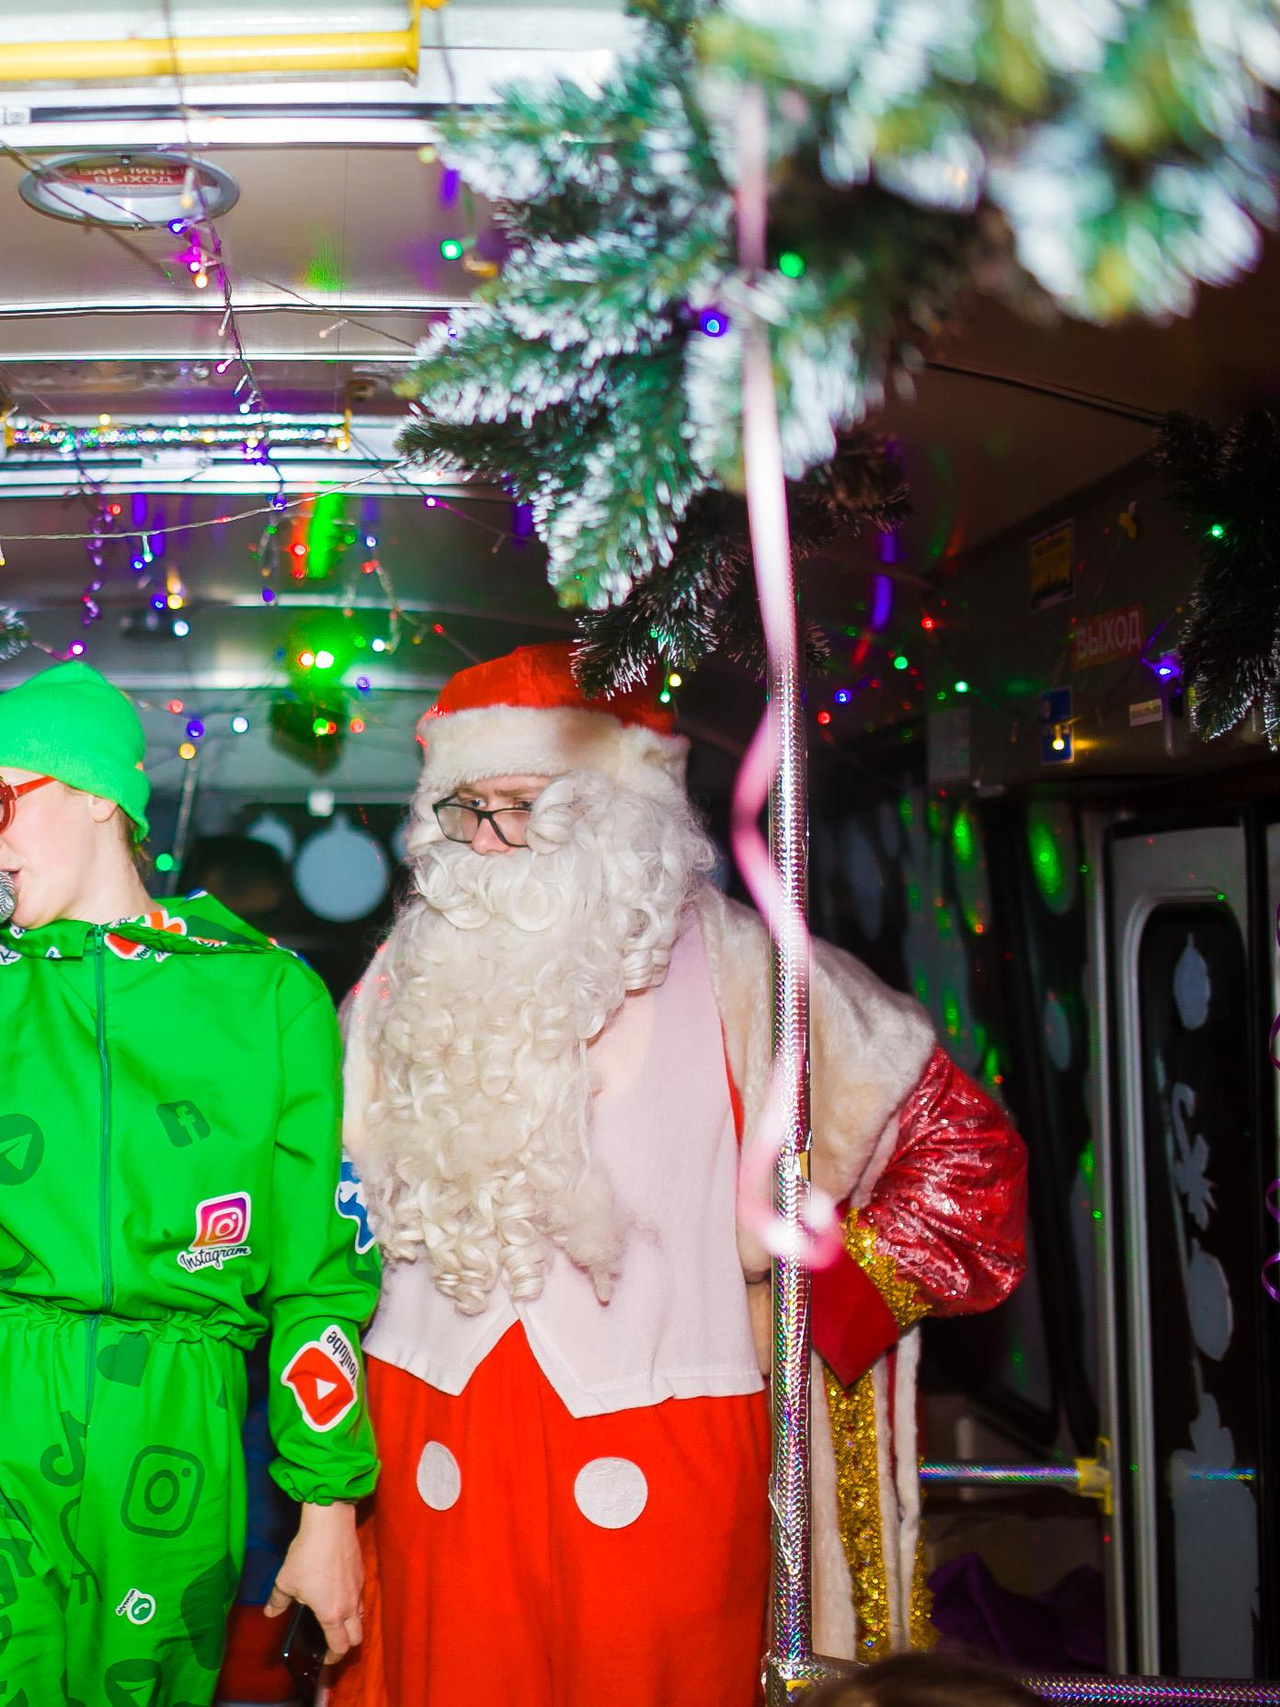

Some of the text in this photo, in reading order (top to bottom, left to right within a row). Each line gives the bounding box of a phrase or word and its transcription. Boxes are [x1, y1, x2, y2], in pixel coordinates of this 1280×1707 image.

[93, 175, 174, 185] ВЫХОД
[1076, 610, 1141, 658] ВЫХОД
[180, 1247, 248, 1271] Instagram
